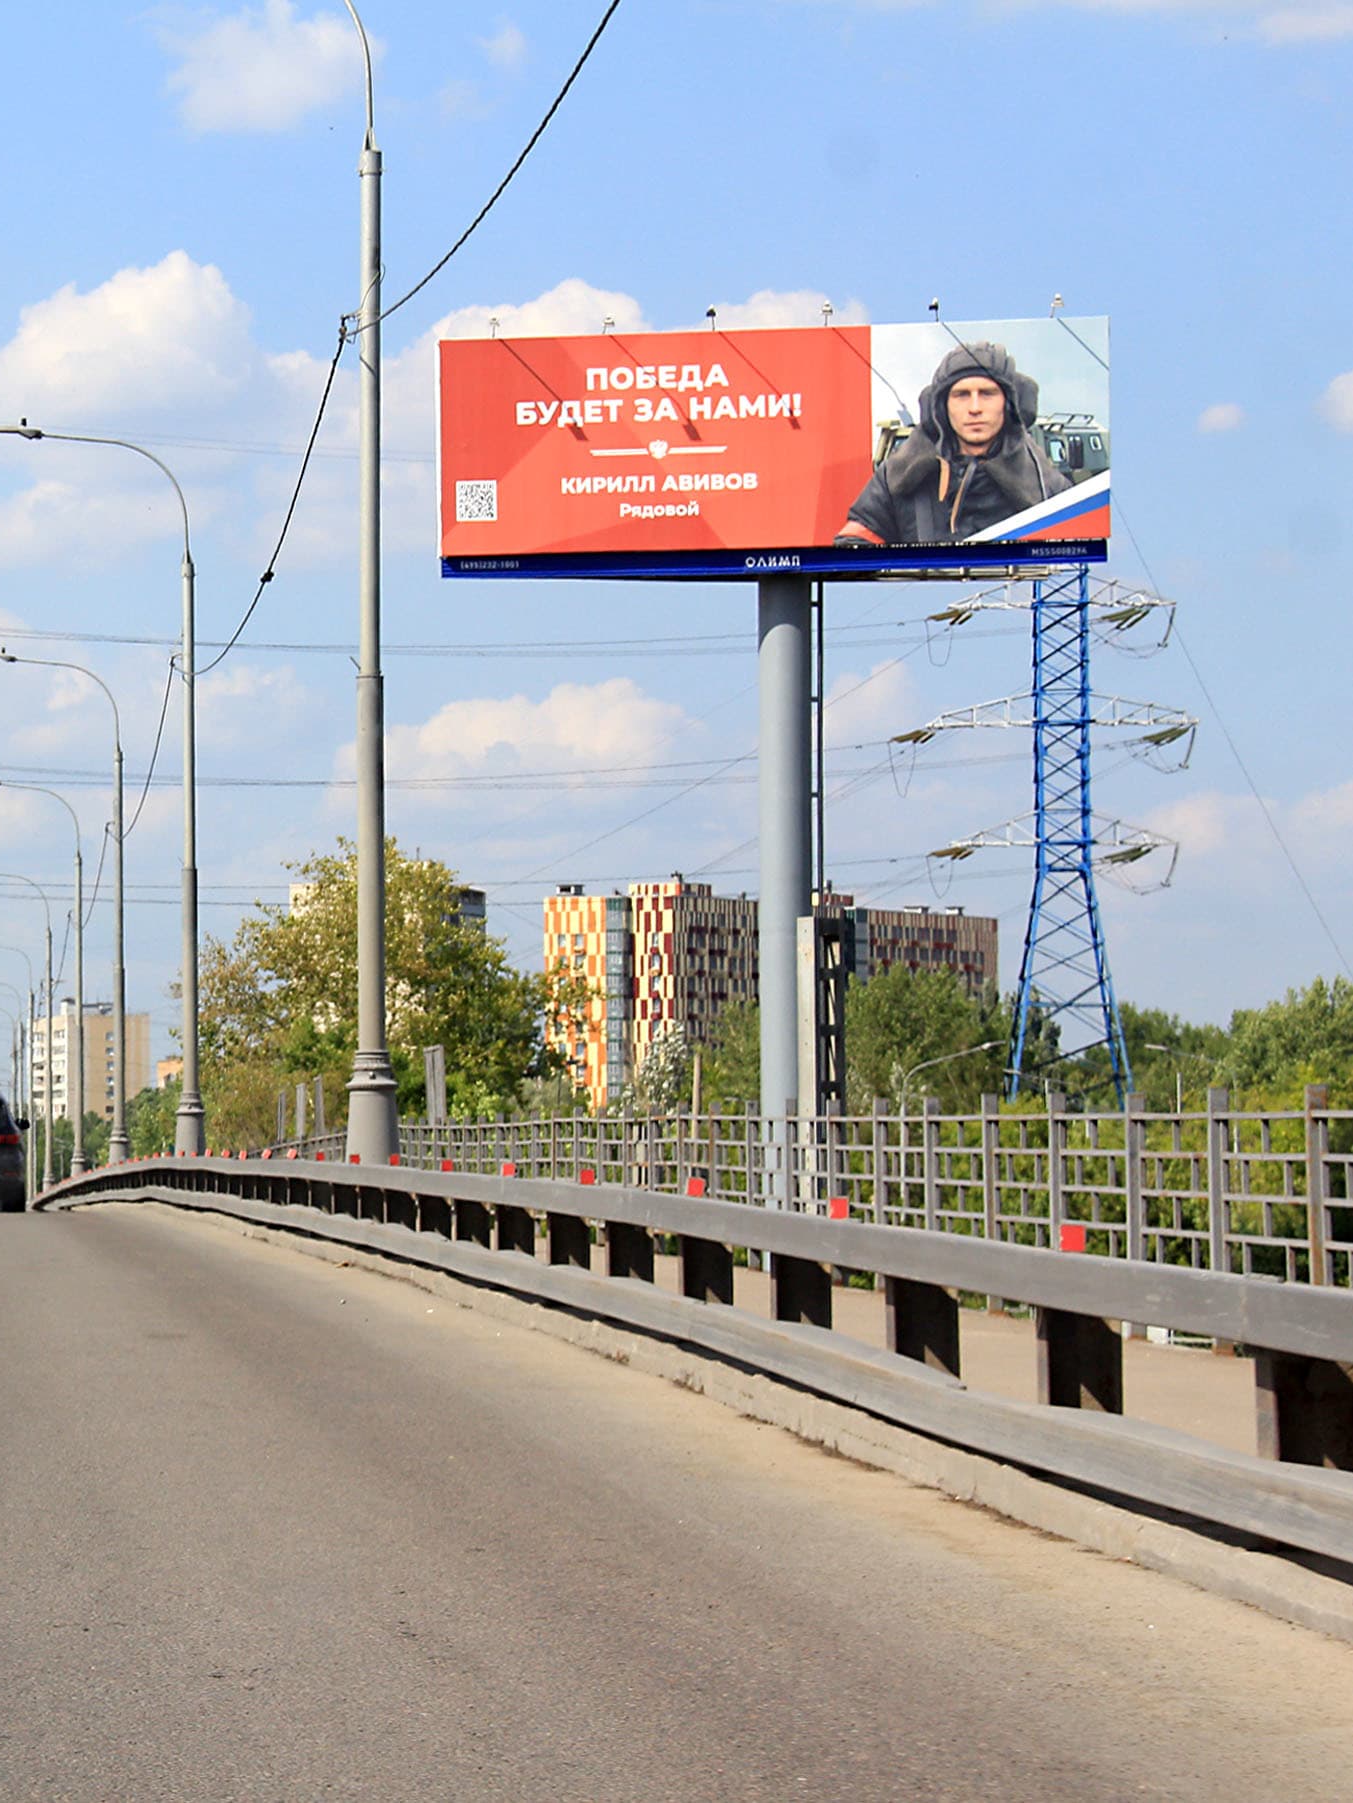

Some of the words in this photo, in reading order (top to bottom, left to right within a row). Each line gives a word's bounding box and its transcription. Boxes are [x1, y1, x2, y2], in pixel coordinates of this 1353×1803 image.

[586, 364, 729, 391] ПОБЕДА
[516, 399, 623, 427] БУДЕТ
[634, 397, 681, 422] ЗА
[689, 394, 802, 420] НАМИ!
[561, 475, 655, 494] КИРИЛЛ
[662, 472, 758, 492] АВИВОВ
[619, 500, 699, 519] Рядовой
[745, 555, 800, 568] ОЛИМП
